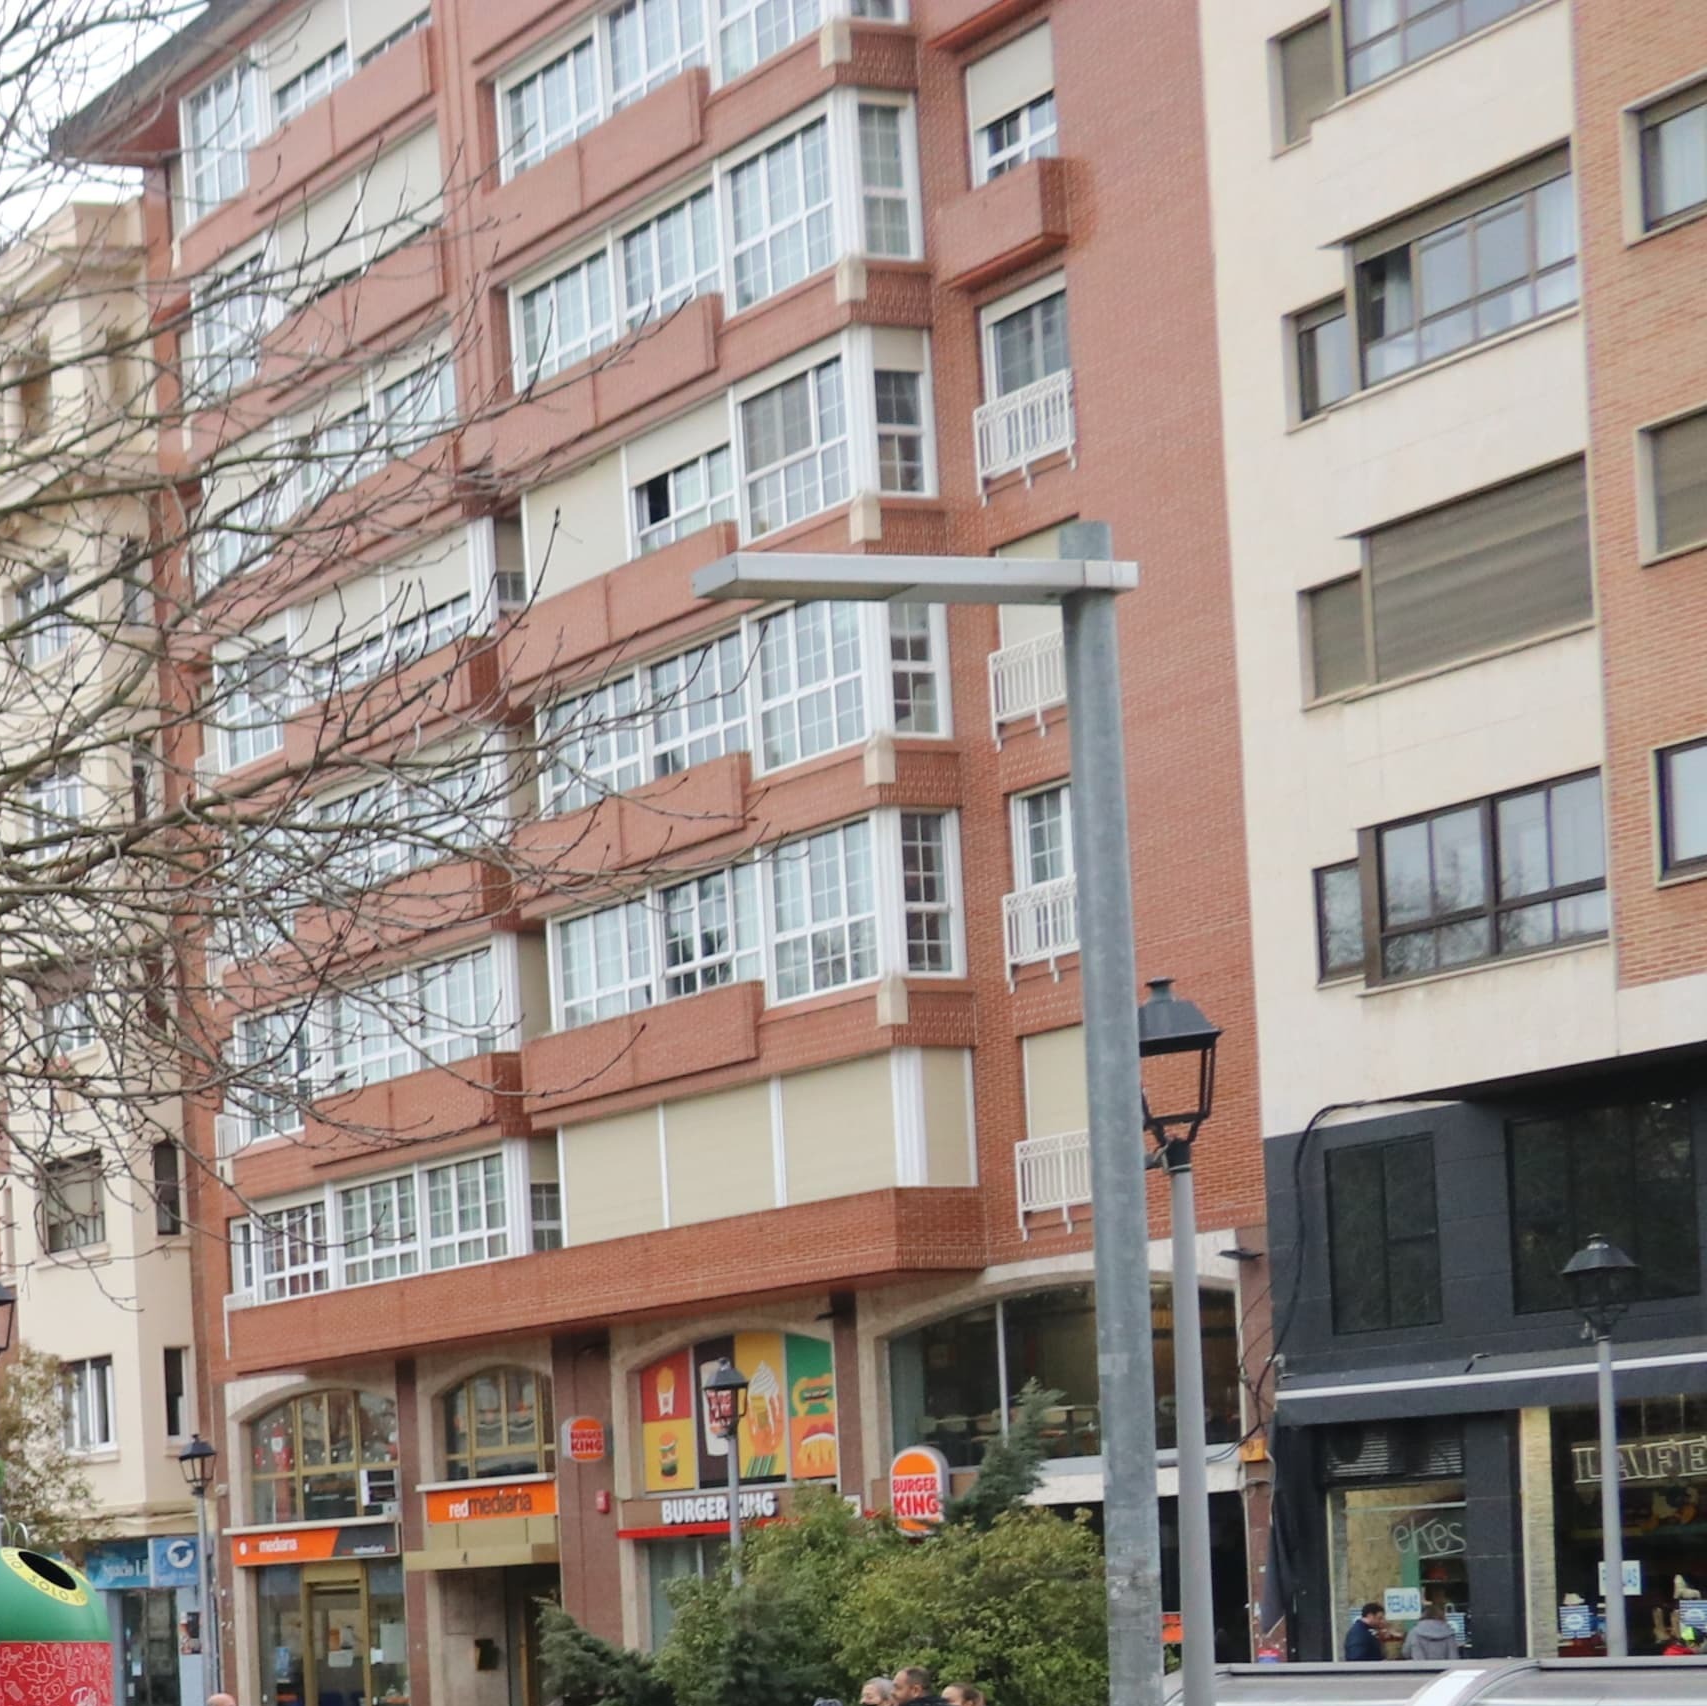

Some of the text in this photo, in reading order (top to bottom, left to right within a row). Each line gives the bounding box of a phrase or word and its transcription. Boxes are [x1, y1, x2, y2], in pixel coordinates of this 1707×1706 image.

[893, 1477, 937, 1493] BURGER
[662, 1496, 728, 1524] BURGER
[894, 1494, 939, 1516] KING
[28, 1573, 70, 1602] SOLO
